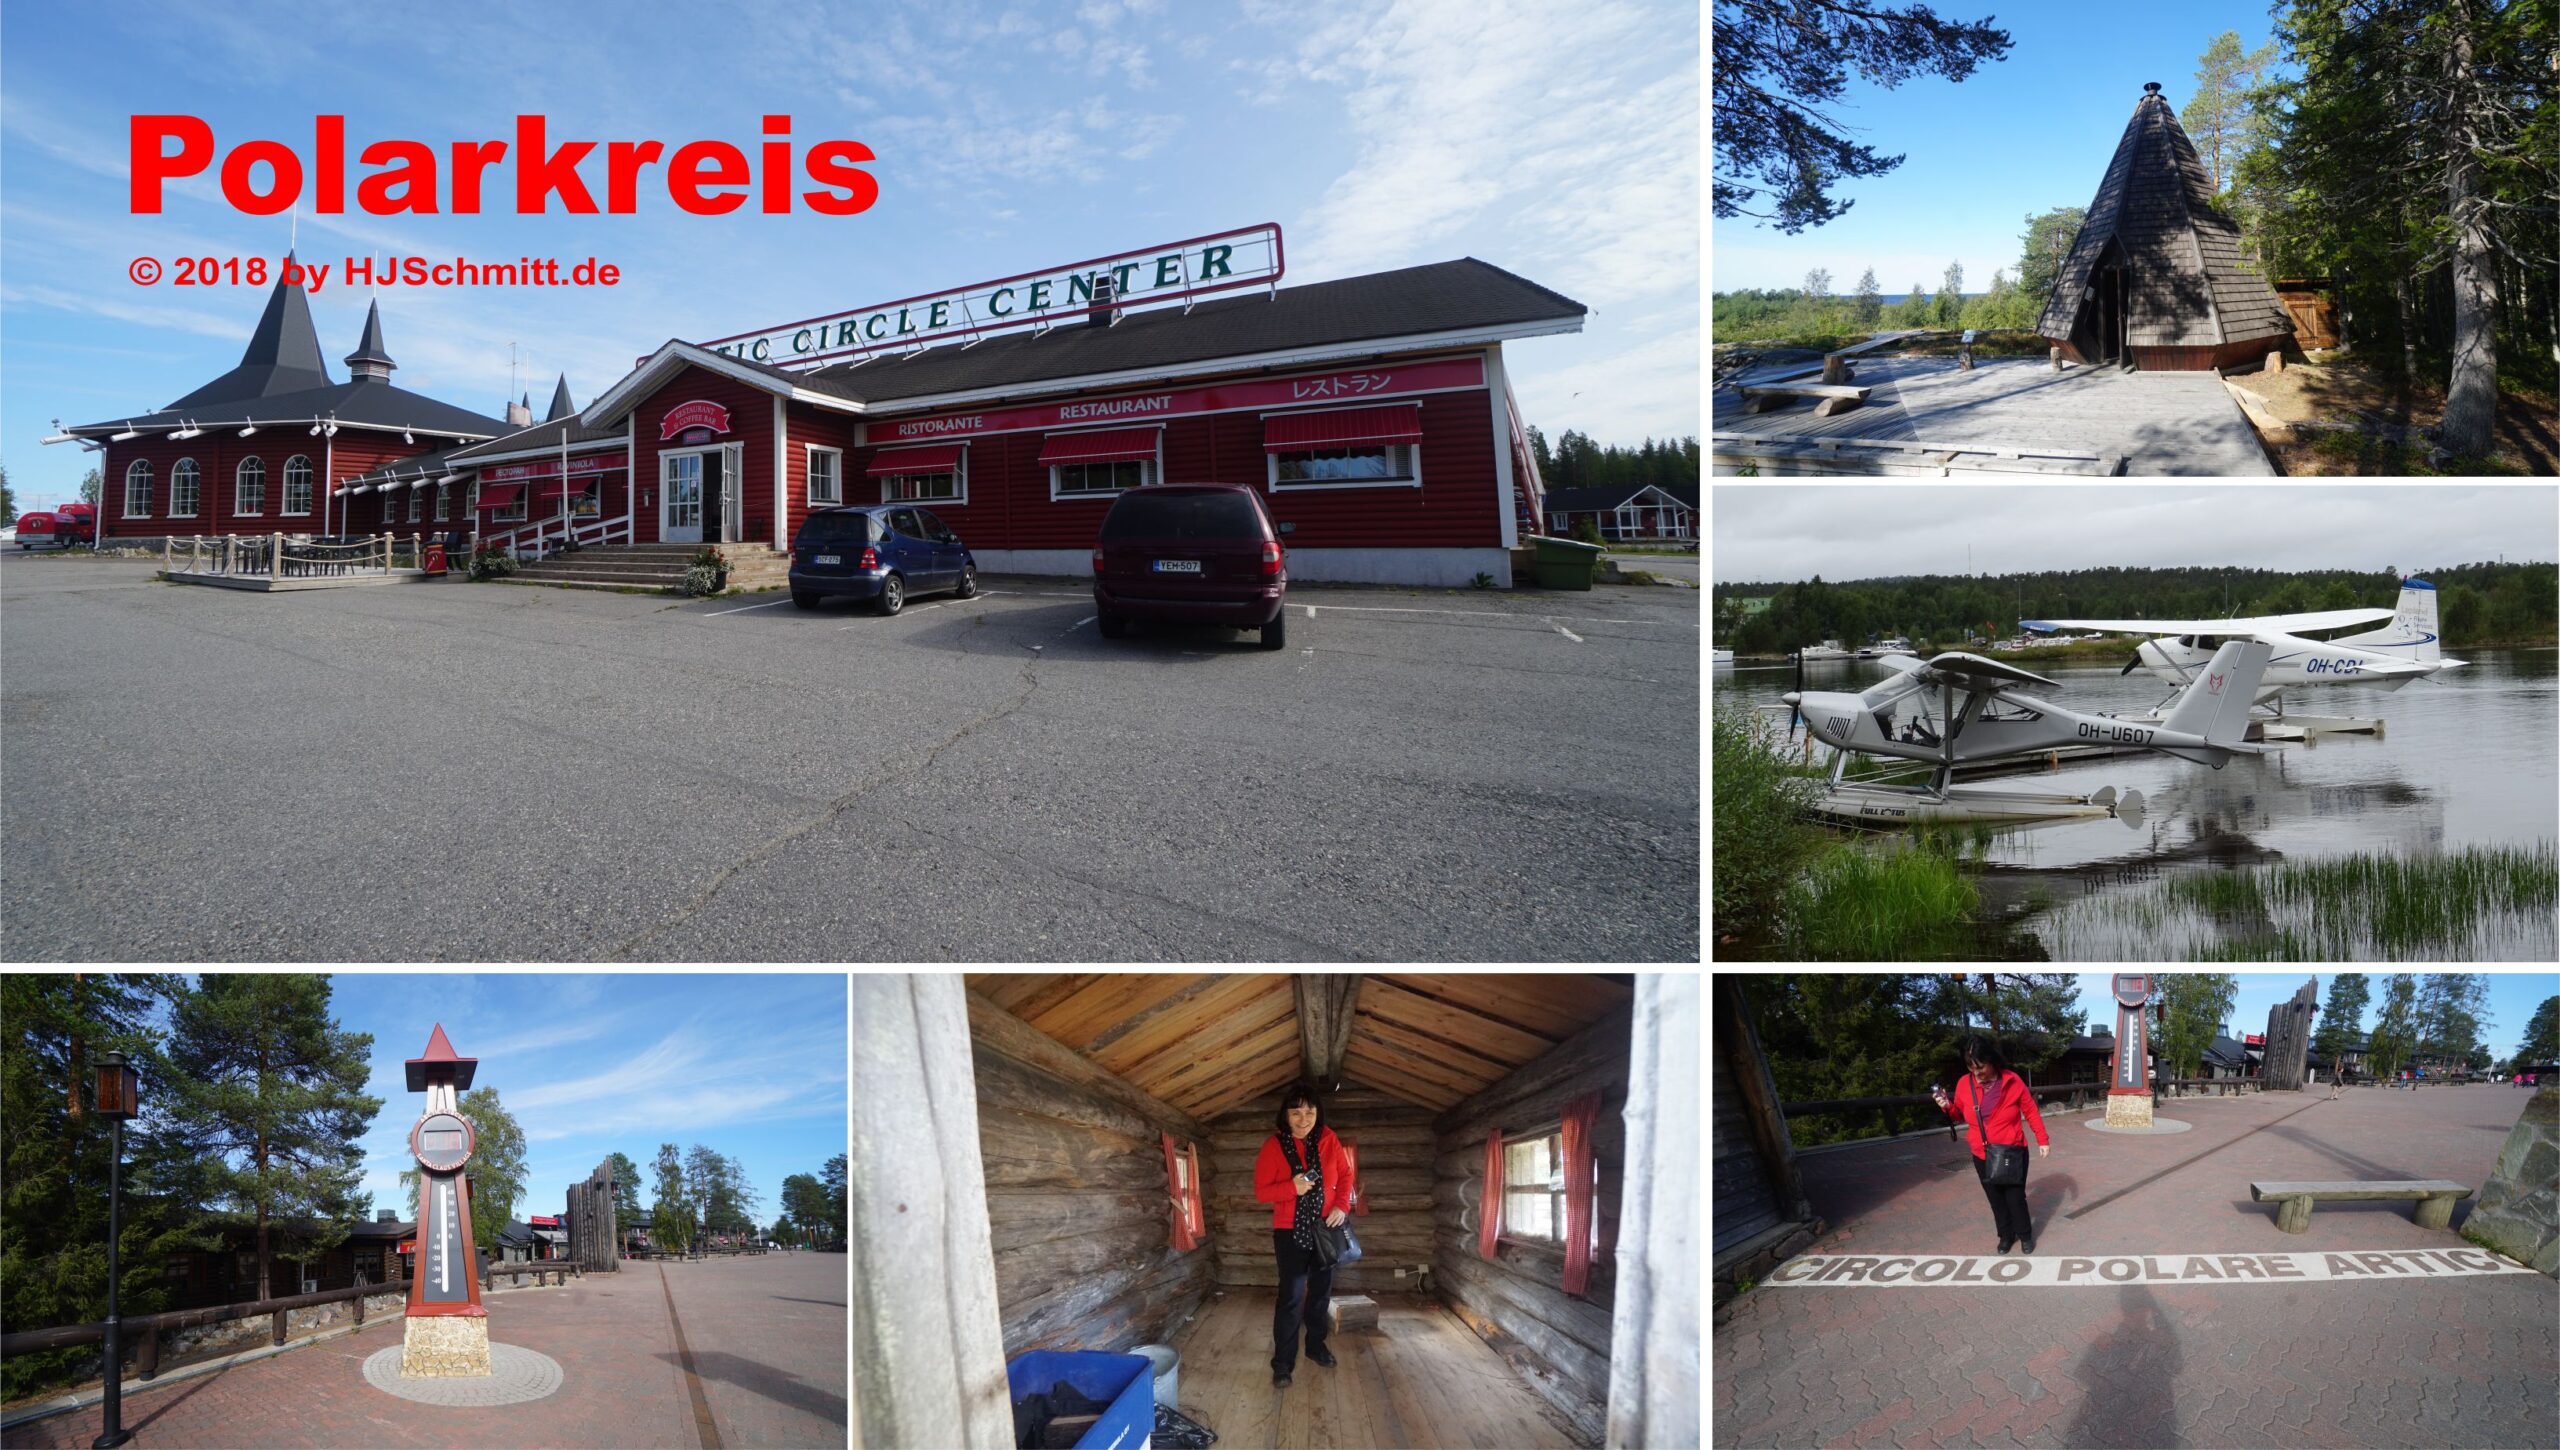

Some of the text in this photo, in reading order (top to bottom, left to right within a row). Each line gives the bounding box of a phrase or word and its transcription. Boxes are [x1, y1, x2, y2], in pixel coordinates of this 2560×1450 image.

[792, 299, 950, 354] CIRCLE
[988, 244, 1233, 317] CENTER
[1293, 374, 1392, 399] レストラン
[675, 405, 715, 420] RESTAURANT
[679, 414, 703, 425] COFFEE
[704, 415, 717, 425] BAR
[898, 396, 1173, 436] RISTORANTE RESTAURANT
[1160, 561, 1198, 571] YEM-507
[2078, 722, 2155, 745] OH-U607
[1771, 1257, 2032, 1283] CIRCOLO
[2057, 1255, 2305, 1282] POLARE
